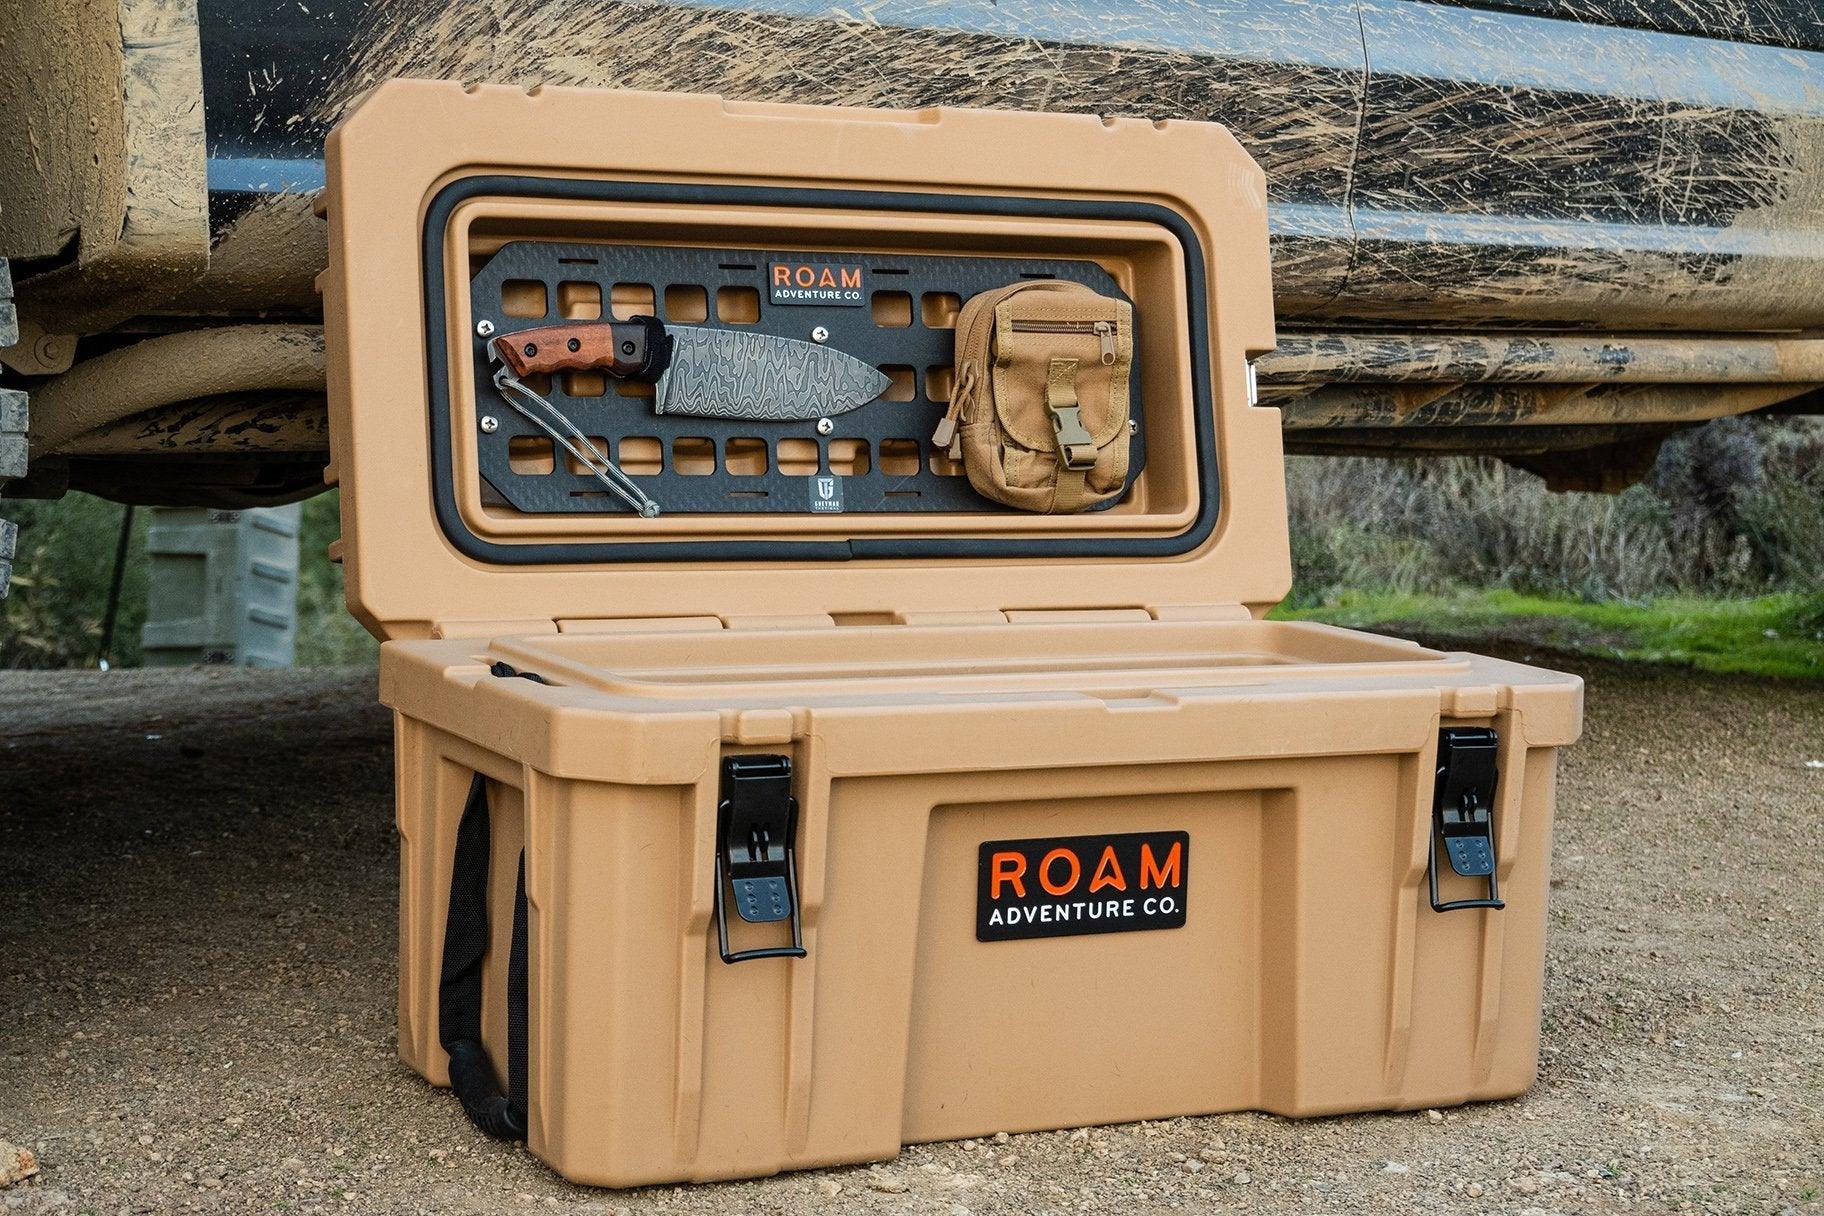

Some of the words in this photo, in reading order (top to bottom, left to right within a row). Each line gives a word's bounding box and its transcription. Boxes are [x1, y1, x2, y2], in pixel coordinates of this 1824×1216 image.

[773, 265, 861, 288] ROAM
[775, 289, 841, 299] ADVENTURE
[844, 291, 862, 300] CO.
[990, 841, 1182, 900] ROAM
[988, 899, 1135, 926] ADVENTURE
[1143, 896, 1180, 916] CO.
